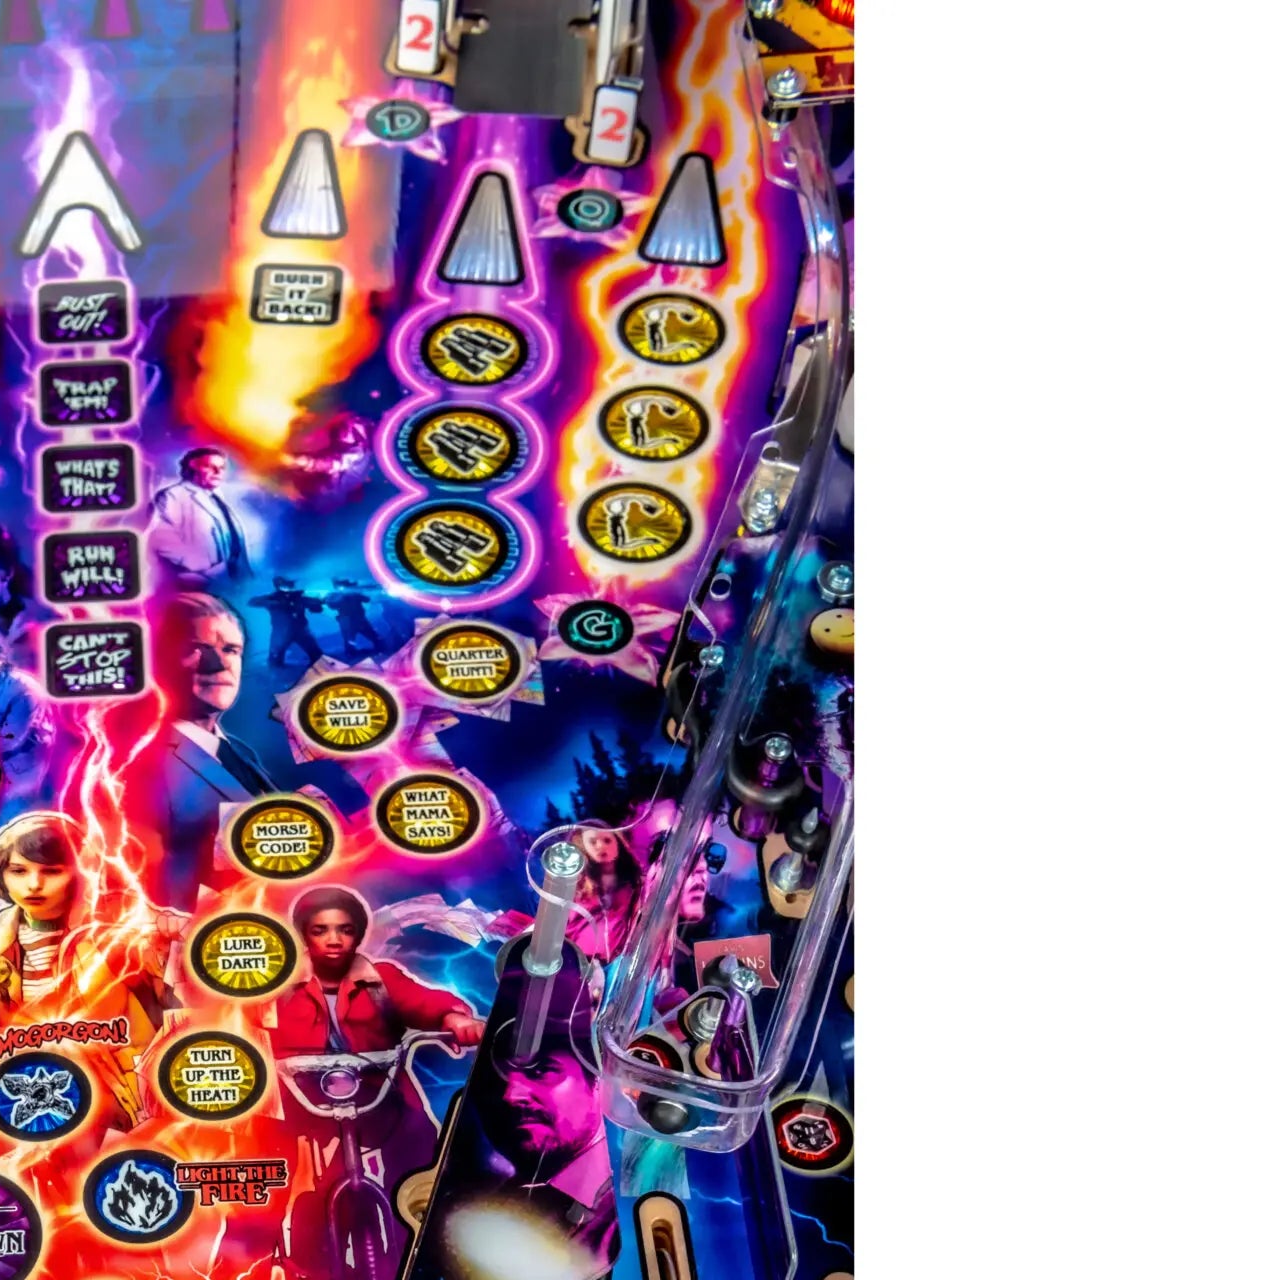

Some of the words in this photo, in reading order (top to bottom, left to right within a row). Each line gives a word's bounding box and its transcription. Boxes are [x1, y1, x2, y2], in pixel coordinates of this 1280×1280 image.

[404, 14, 433, 52] 2
[597, 107, 628, 142] 2
[273, 272, 324, 286] BURN
[289, 288, 306, 301] IT
[51, 293, 118, 312] BUST
[269, 302, 323, 317] BACK!
[58, 310, 109, 332] OUT!
[52, 377, 118, 397] TRAP
[60, 477, 117, 498] THAT?
[67, 545, 115, 568] RUN
[61, 567, 125, 589] WILL!
[58, 633, 129, 652] CAN'T
[56, 649, 132, 670] STOP
[435, 650, 505, 663] QUARTER
[63, 667, 126, 687] THIS!
[449, 666, 494, 678] HUNT!
[328, 699, 367, 711] SAVE
[329, 716, 369, 728] WILL!
[404, 790, 448, 803] WHAT
[406, 808, 450, 821] MAMA
[256, 824, 309, 837] MORSE
[408, 825, 451, 838] SAYS!
[259, 842, 307, 854] CODE!
[223, 938, 263, 951] LURE
[221, 957, 266, 970] DART!
[190, 1049, 232, 1062] TURN
[185, 1070, 205, 1082] UP
[210, 1069, 241, 1082] THE
[190, 1089, 237, 1102] HEAT!
[176, 1165, 241, 1182] LIGHT
[245, 1164, 287, 1181] THE
[200, 1183, 269, 1206] FIRE
